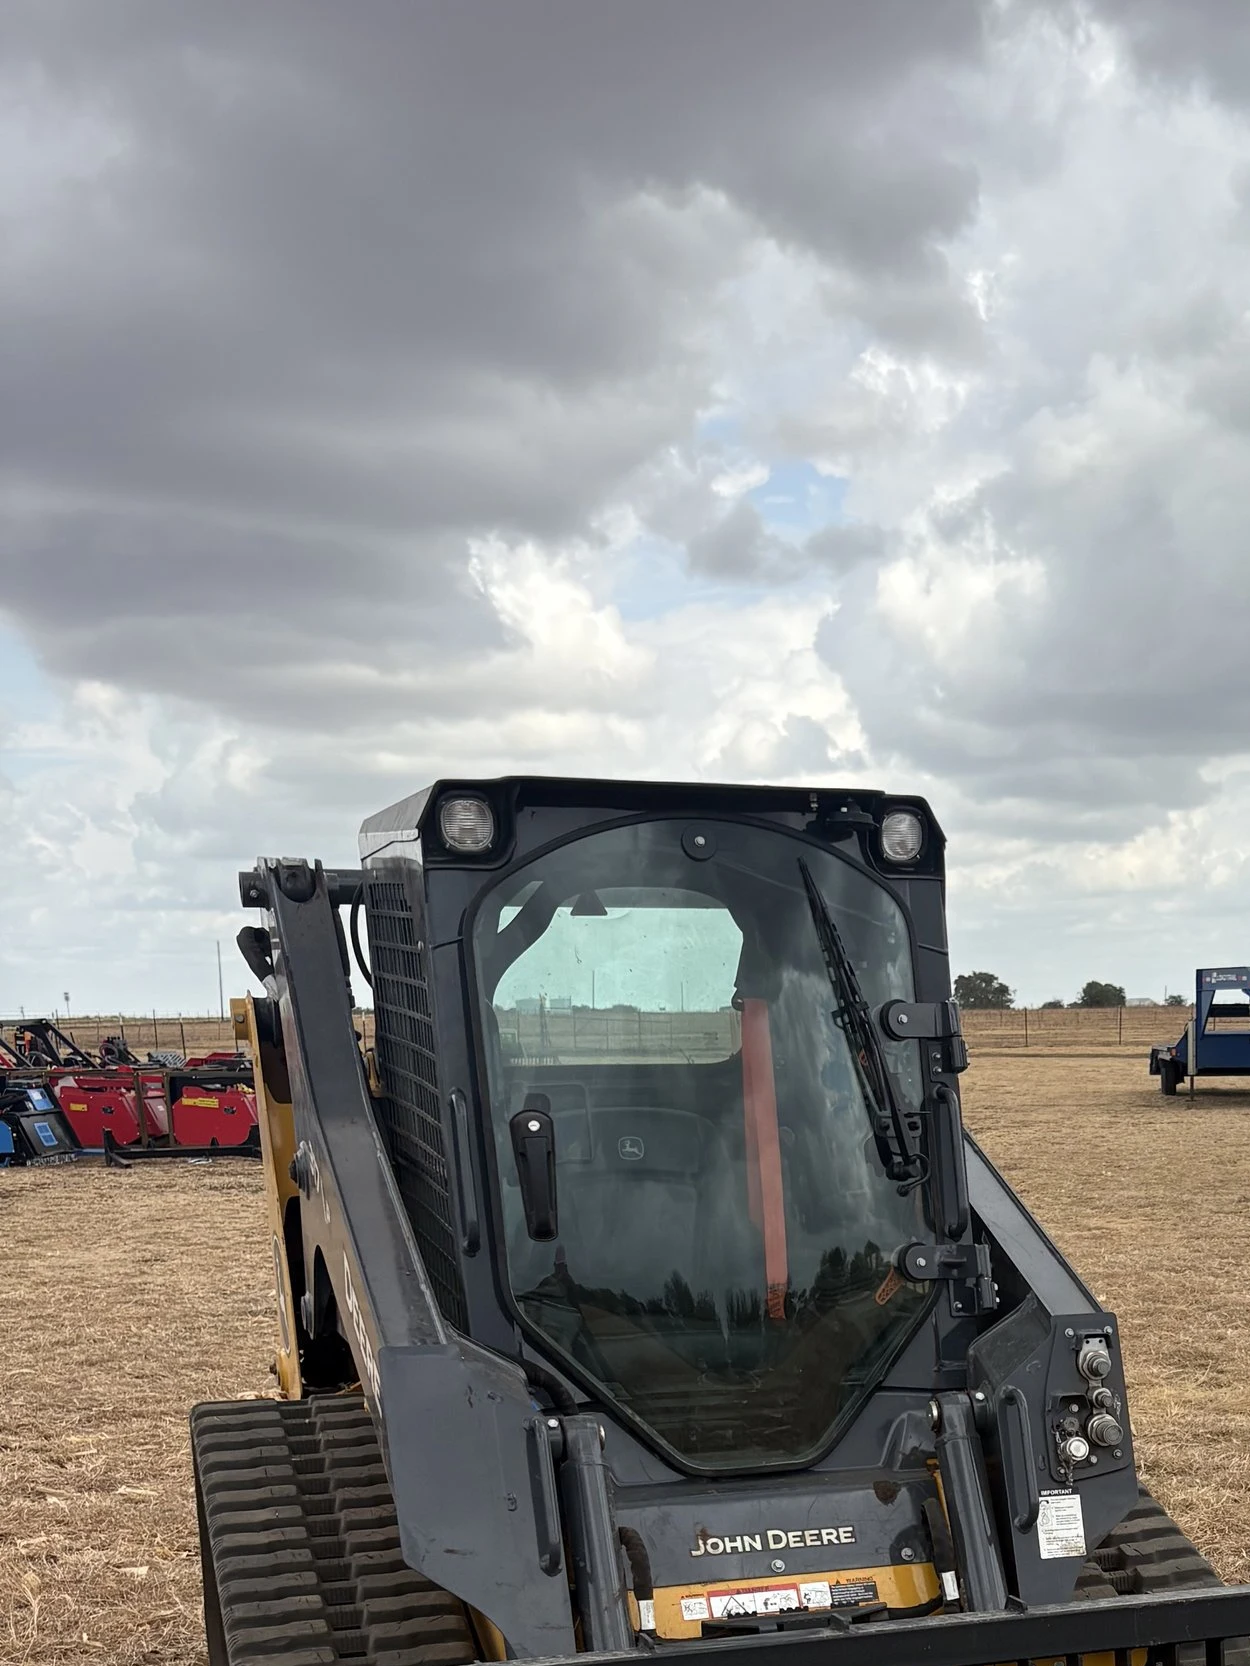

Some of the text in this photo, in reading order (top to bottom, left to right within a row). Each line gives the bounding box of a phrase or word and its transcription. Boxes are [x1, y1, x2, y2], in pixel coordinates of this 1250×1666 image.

[1040, 1488, 1073, 1496] IMPORTANT
[690, 1526, 857, 1557] JOHN DEERE
